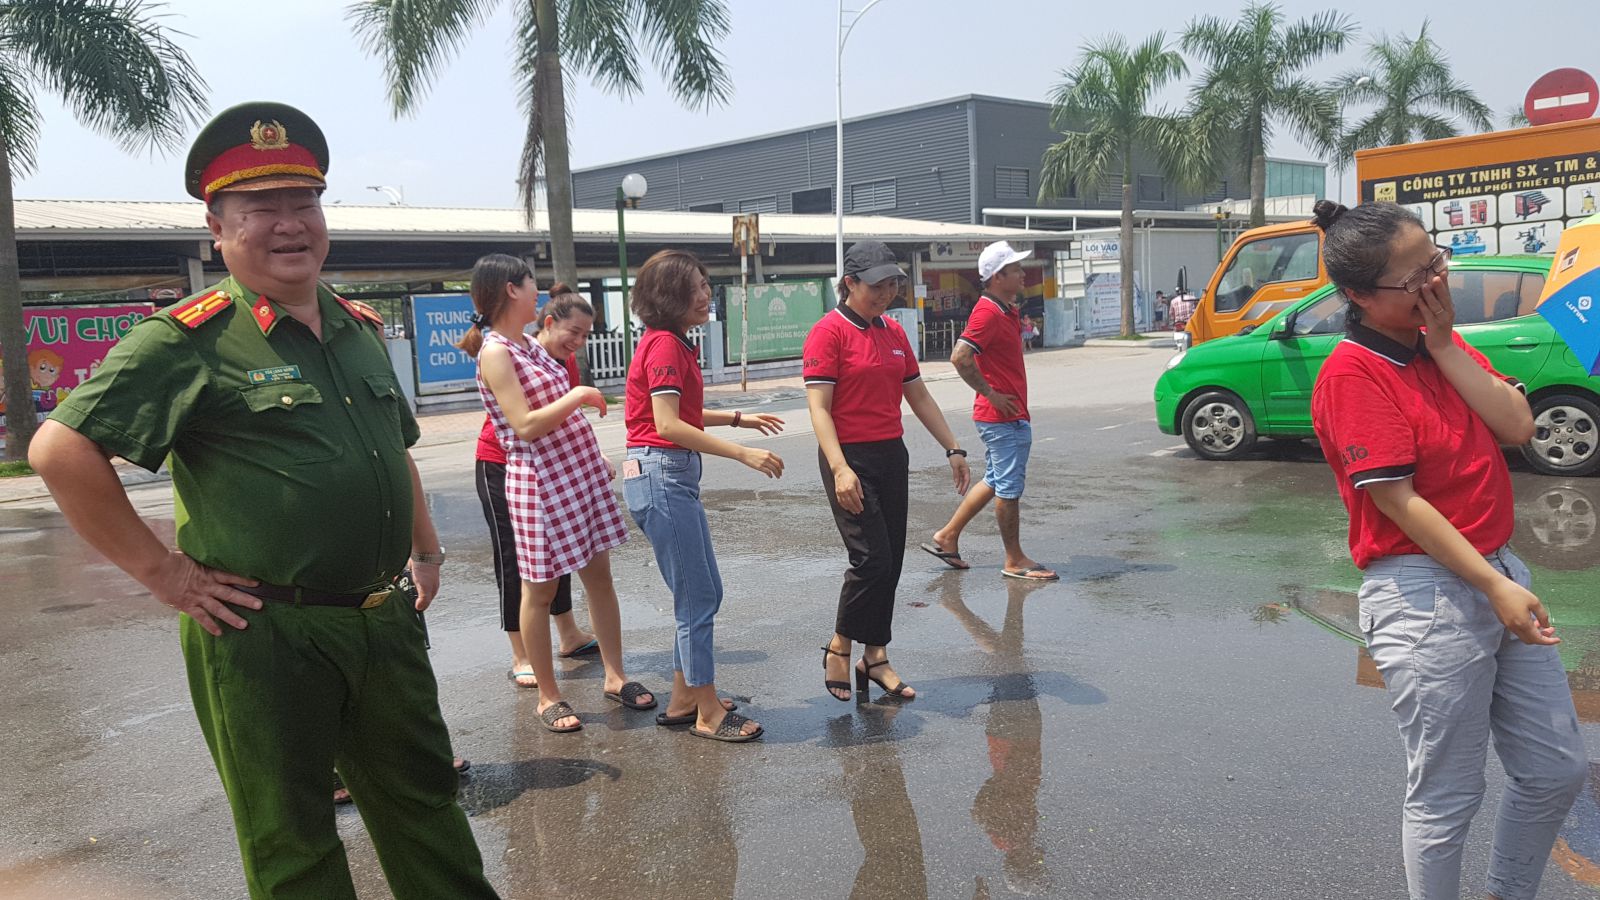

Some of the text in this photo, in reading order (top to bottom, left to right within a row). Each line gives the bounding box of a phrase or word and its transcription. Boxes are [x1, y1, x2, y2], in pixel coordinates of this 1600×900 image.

[1402, 176, 1443, 192] CÔNG
[1448, 173, 1465, 186] TY
[1470, 167, 1511, 183] TNHH
[1516, 163, 1537, 178] SX
[1554, 159, 1578, 173] TM
[1585, 156, 1597, 169] &
[1516, 177, 1549, 188] THIẾT
[1552, 176, 1565, 185] BỊ
[425, 310, 472, 325] TRUNG
[430, 352, 456, 366] CHO
